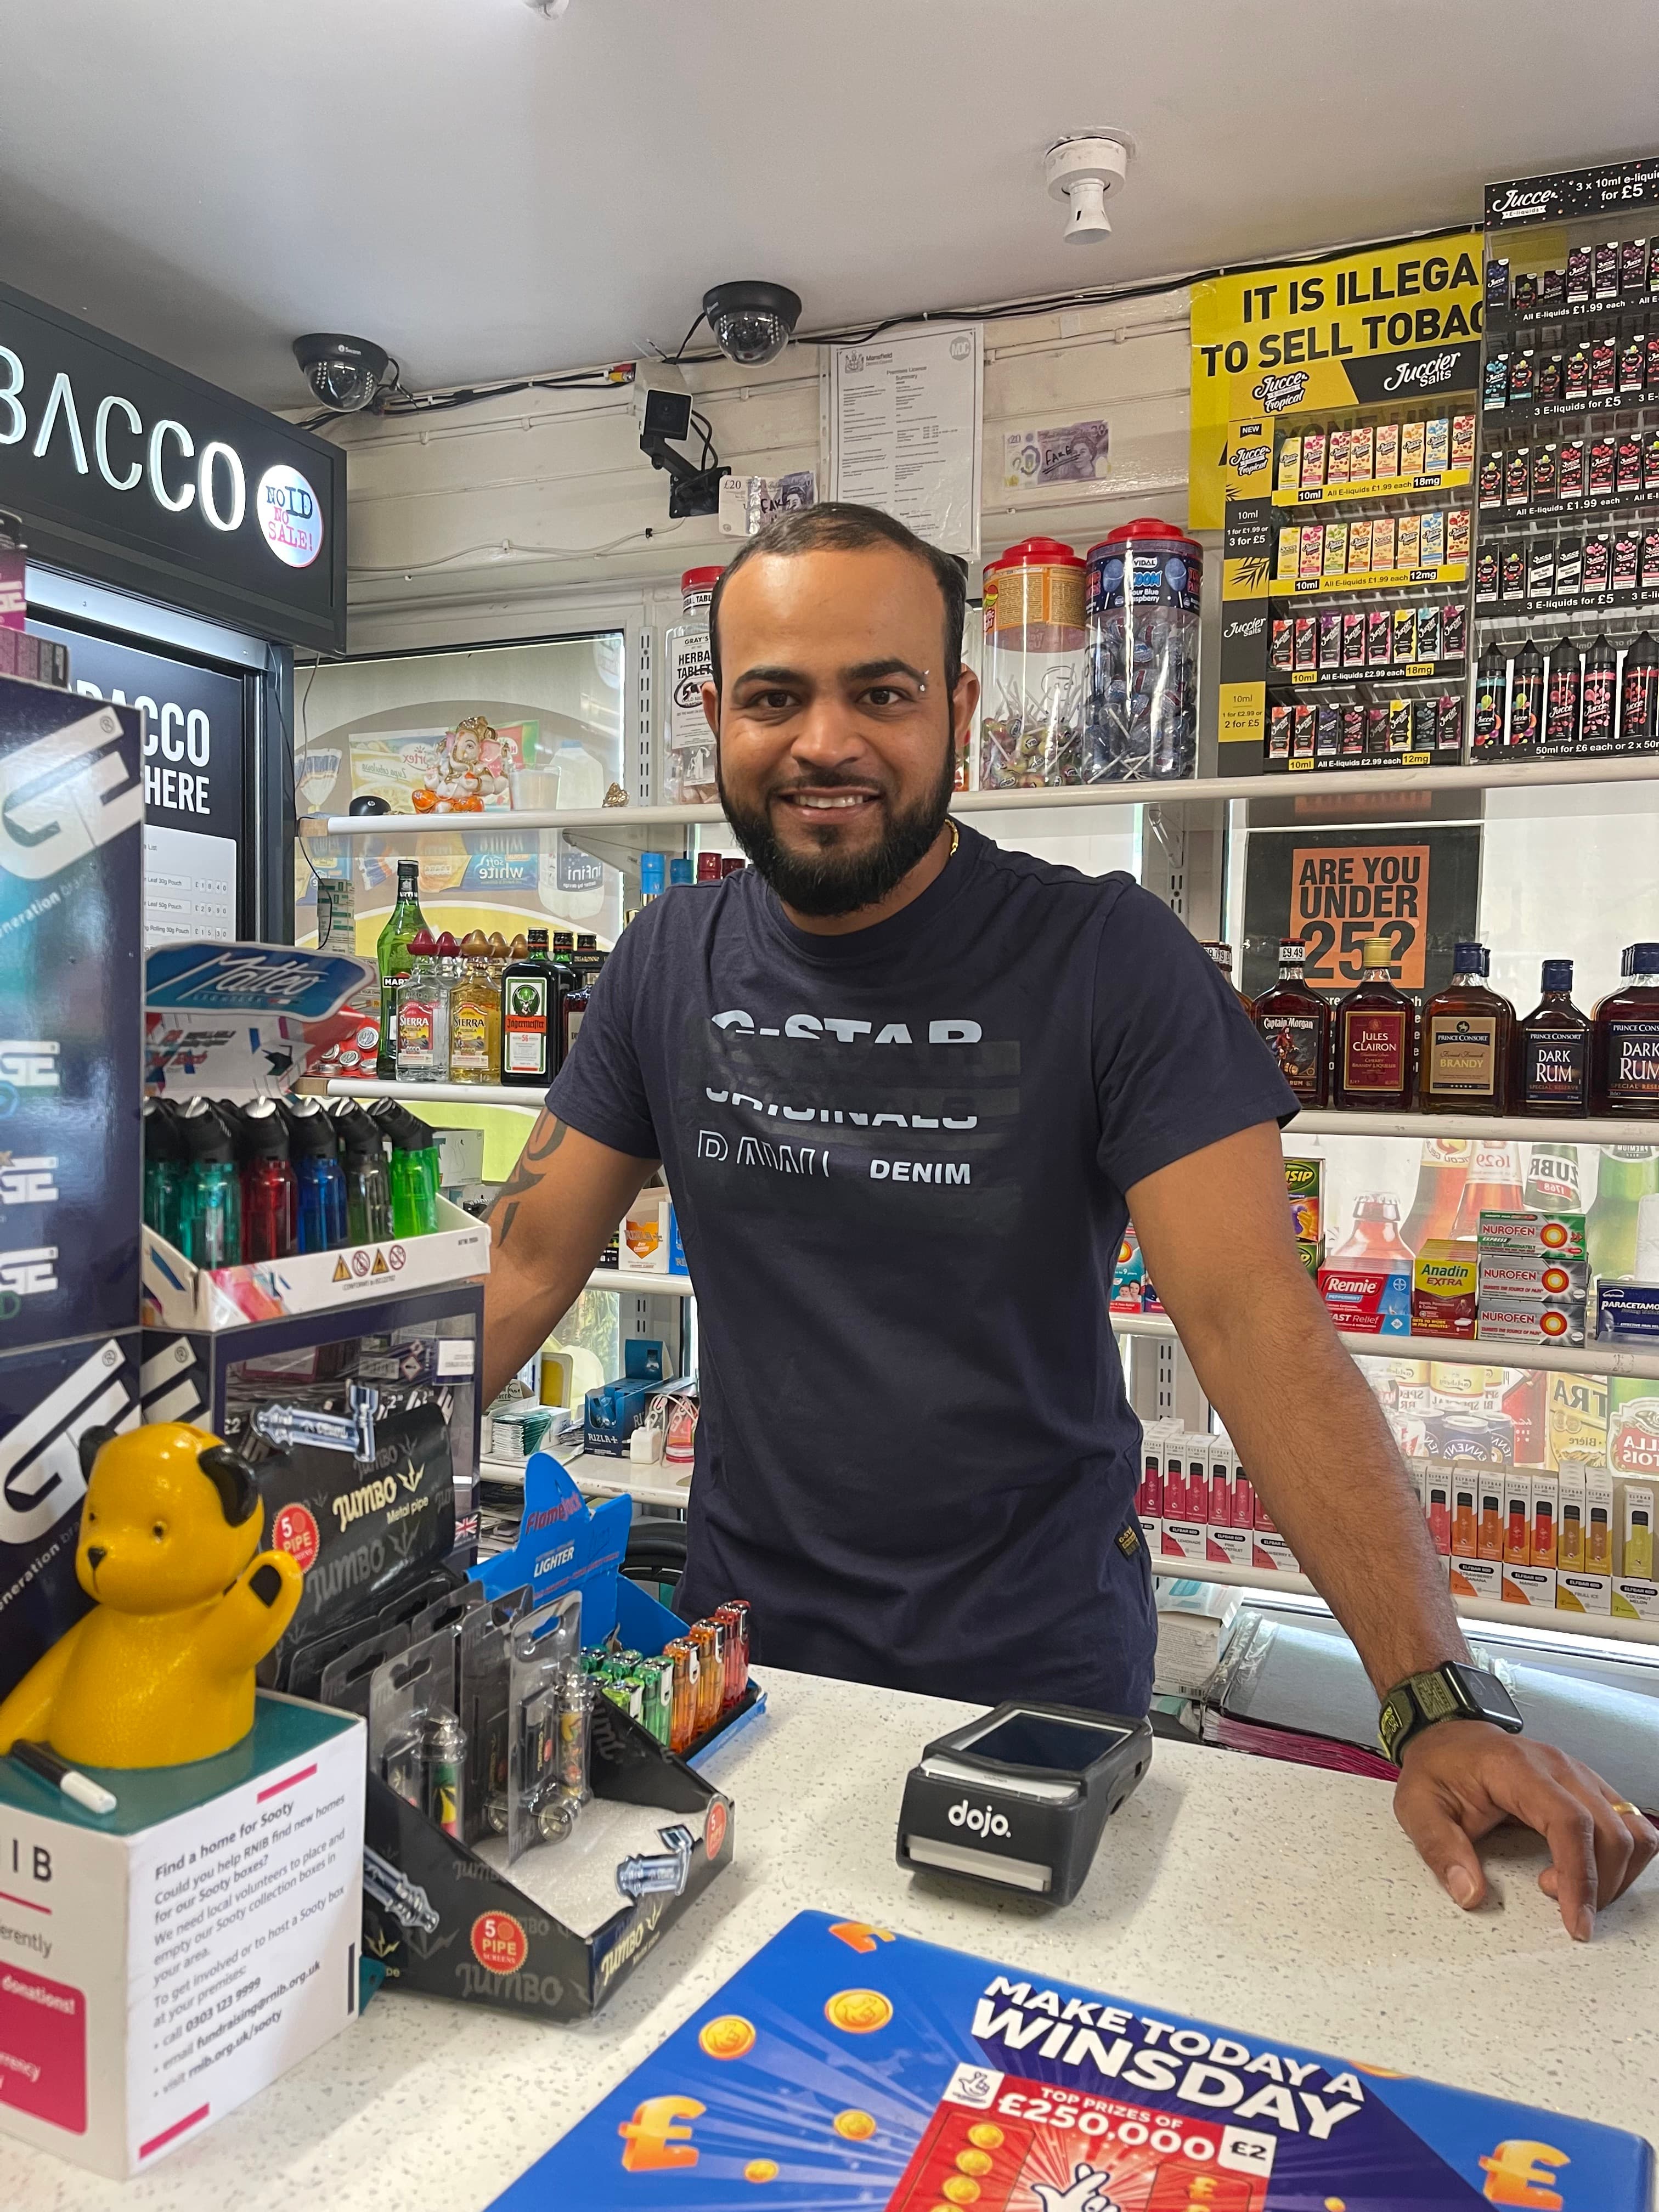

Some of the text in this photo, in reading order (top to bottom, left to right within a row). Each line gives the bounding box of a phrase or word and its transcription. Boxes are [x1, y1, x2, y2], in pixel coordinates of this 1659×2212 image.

[1576, 182, 1583, 191] 3
[1596, 176, 1621, 188] 10ml
[1624, 170, 1659, 183] e-liqui
[1601, 183, 1644, 201] for £5
[1243, 284, 1278, 323] IT
[1289, 278, 1325, 315] IS
[1536, 308, 1570, 320] E-liquids
[1573, 302, 1603, 315] £1.99
[1606, 301, 1626, 309] each
[1200, 340, 1249, 377] TO
[1258, 323, 1353, 369] SELL
[1384, 351, 1461, 392] Juccier
[1419, 369, 1452, 388] Salts
[1264, 389, 1305, 413] Tropical
[1534, 396, 1622, 416] 3 E-liquids for £5
[1242, 425, 1260, 434] NEW
[724, 479, 742, 490] £20
[1299, 490, 1322, 500] 10ml
[1339, 485, 1370, 498] E-liquids
[1372, 482, 1392, 492] £1.99
[1393, 481, 1412, 489] each
[1414, 475, 1441, 488] 18mg
[266, 485, 313, 519] NO ID
[274, 506, 290, 526] NO
[268, 522, 313, 551] SALE!
[1238, 537, 1251, 545] for
[1253, 535, 1266, 544] £5
[1133, 557, 1156, 566] VIDAL
[679, 651, 710, 665] HERBA
[1536, 744, 1559, 755] 50ml
[1560, 743, 1575, 754] for
[1575, 742, 1588, 753] £6
[1590, 742, 1613, 752] each
[1615, 743, 1626, 751] or
[1627, 742, 1633, 750] 2
[144, 765, 211, 815] HERE
[1299, 856, 1421, 886] ARE YOU
[1299, 884, 1419, 919] UNDER
[1282, 947, 1303, 958] £9.49
[399, 1015, 429, 1026] SIERRA
[454, 1017, 484, 1027] SIERRA
[1263, 1017, 1314, 1030] Captain Morgan
[1352, 1042, 1397, 1051] CLAIRON
[1362, 1031, 1388, 1043] JULES
[1440, 1059, 1483, 1068] BRANDY
[1539, 1049, 1571, 1063] DARK
[1537, 1063, 1572, 1083] RUM
[870, 1159, 970, 1184] DENIM
[1483, 1224, 1535, 1235] NUROFEN
[1421, 1263, 1469, 1278] Anadin
[1328, 1278, 1377, 1294] Rennie
[1427, 1277, 1464, 1286] EXTRA
[1328, 1294, 1361, 1302] PEPPERMINT
[1352, 1314, 1380, 1324] Relief
[332, 1475, 398, 1533] JUMBO
[386, 1496, 429, 1525] Metal pipe
[281, 1517, 293, 1538] 5
[534, 1545, 575, 1578] LIGHTER
[948, 1799, 1012, 1838] dojo.
[154, 1794, 346, 1905] Could you help RNIB find new homes
[155, 1800, 295, 1881] Find a home for Sooty
[154, 1827, 345, 1947] We need local volunteers to place and
[485, 1920, 496, 1938] 5
[482, 1938, 517, 1956] PIPE
[162, 1977, 262, 2047] call 0303 123 9999
[196, 1960, 321, 2050] fundraising@rnib.org.uk
[188, 2008, 283, 2079] rnib.org.uk/sooty
[984, 1976, 1365, 2102] MAKE TODAY A
[971, 1997, 1363, 2141] WINSDAY
[1040, 2085, 1184, 2129] TOP PRIZES OF
[998, 2092, 1217, 2162] £250,000
[1230, 2140, 1267, 2162] £2
